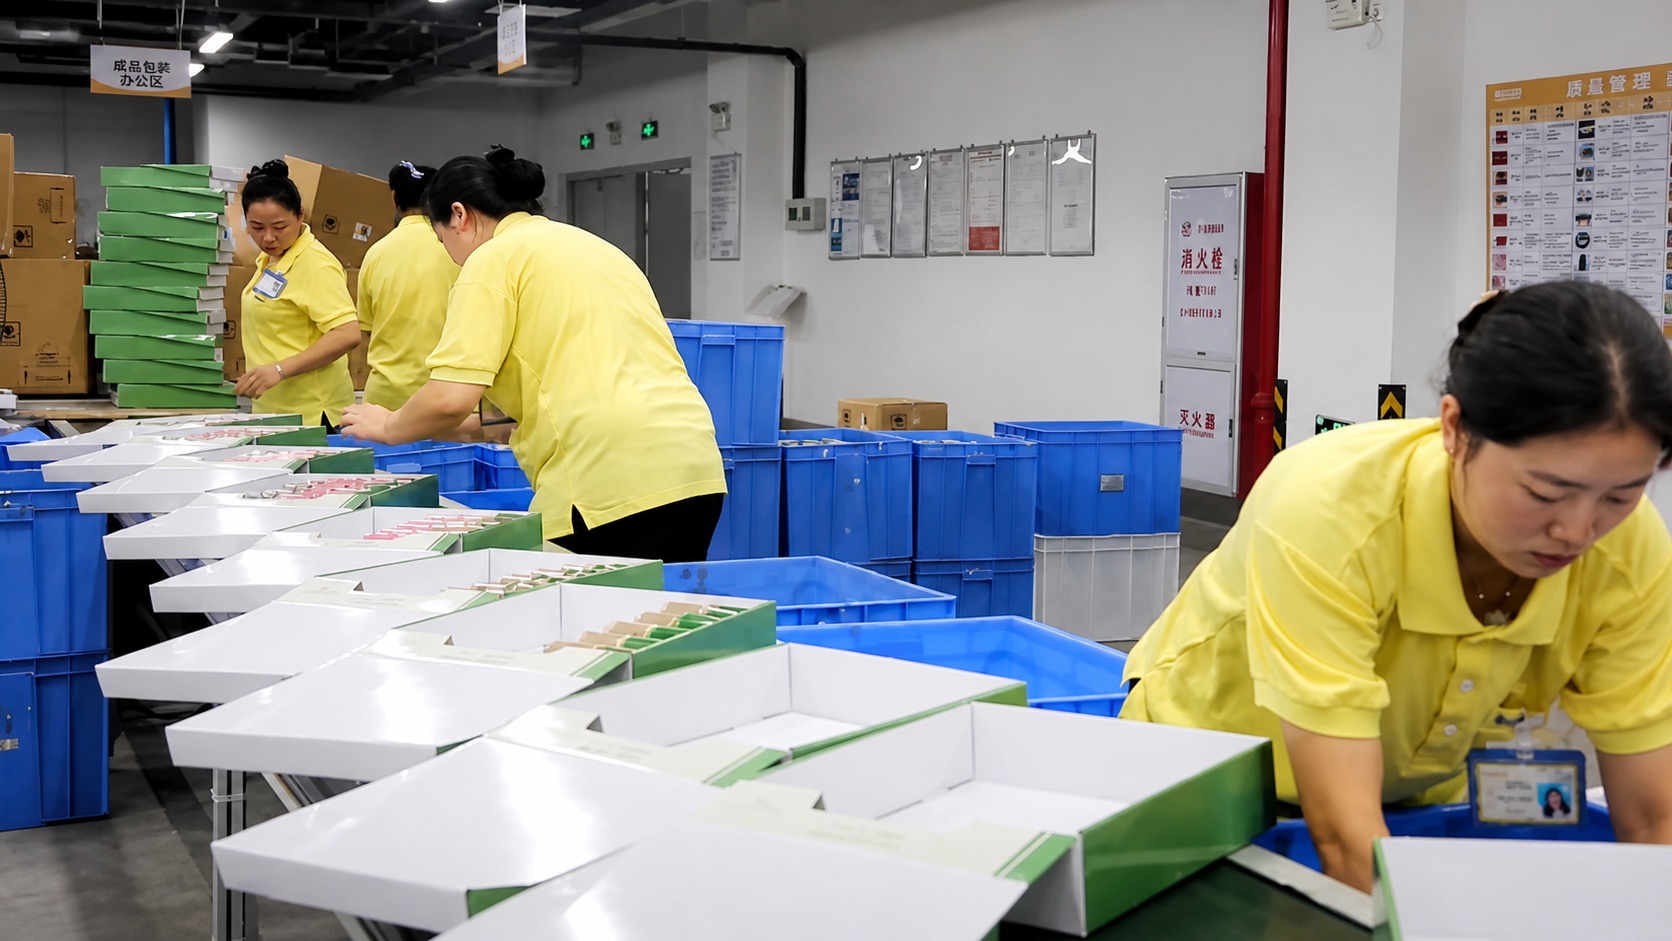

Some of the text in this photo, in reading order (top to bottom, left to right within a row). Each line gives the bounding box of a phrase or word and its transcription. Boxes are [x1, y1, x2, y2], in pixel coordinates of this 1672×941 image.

[113, 59, 171, 74] 成品包装
[120, 74, 164, 89] 办公区
[1566, 71, 1651, 98] 质量管理
[1181, 247, 1223, 270] 消火栓
[1179, 408, 1215, 430] 灭火器
